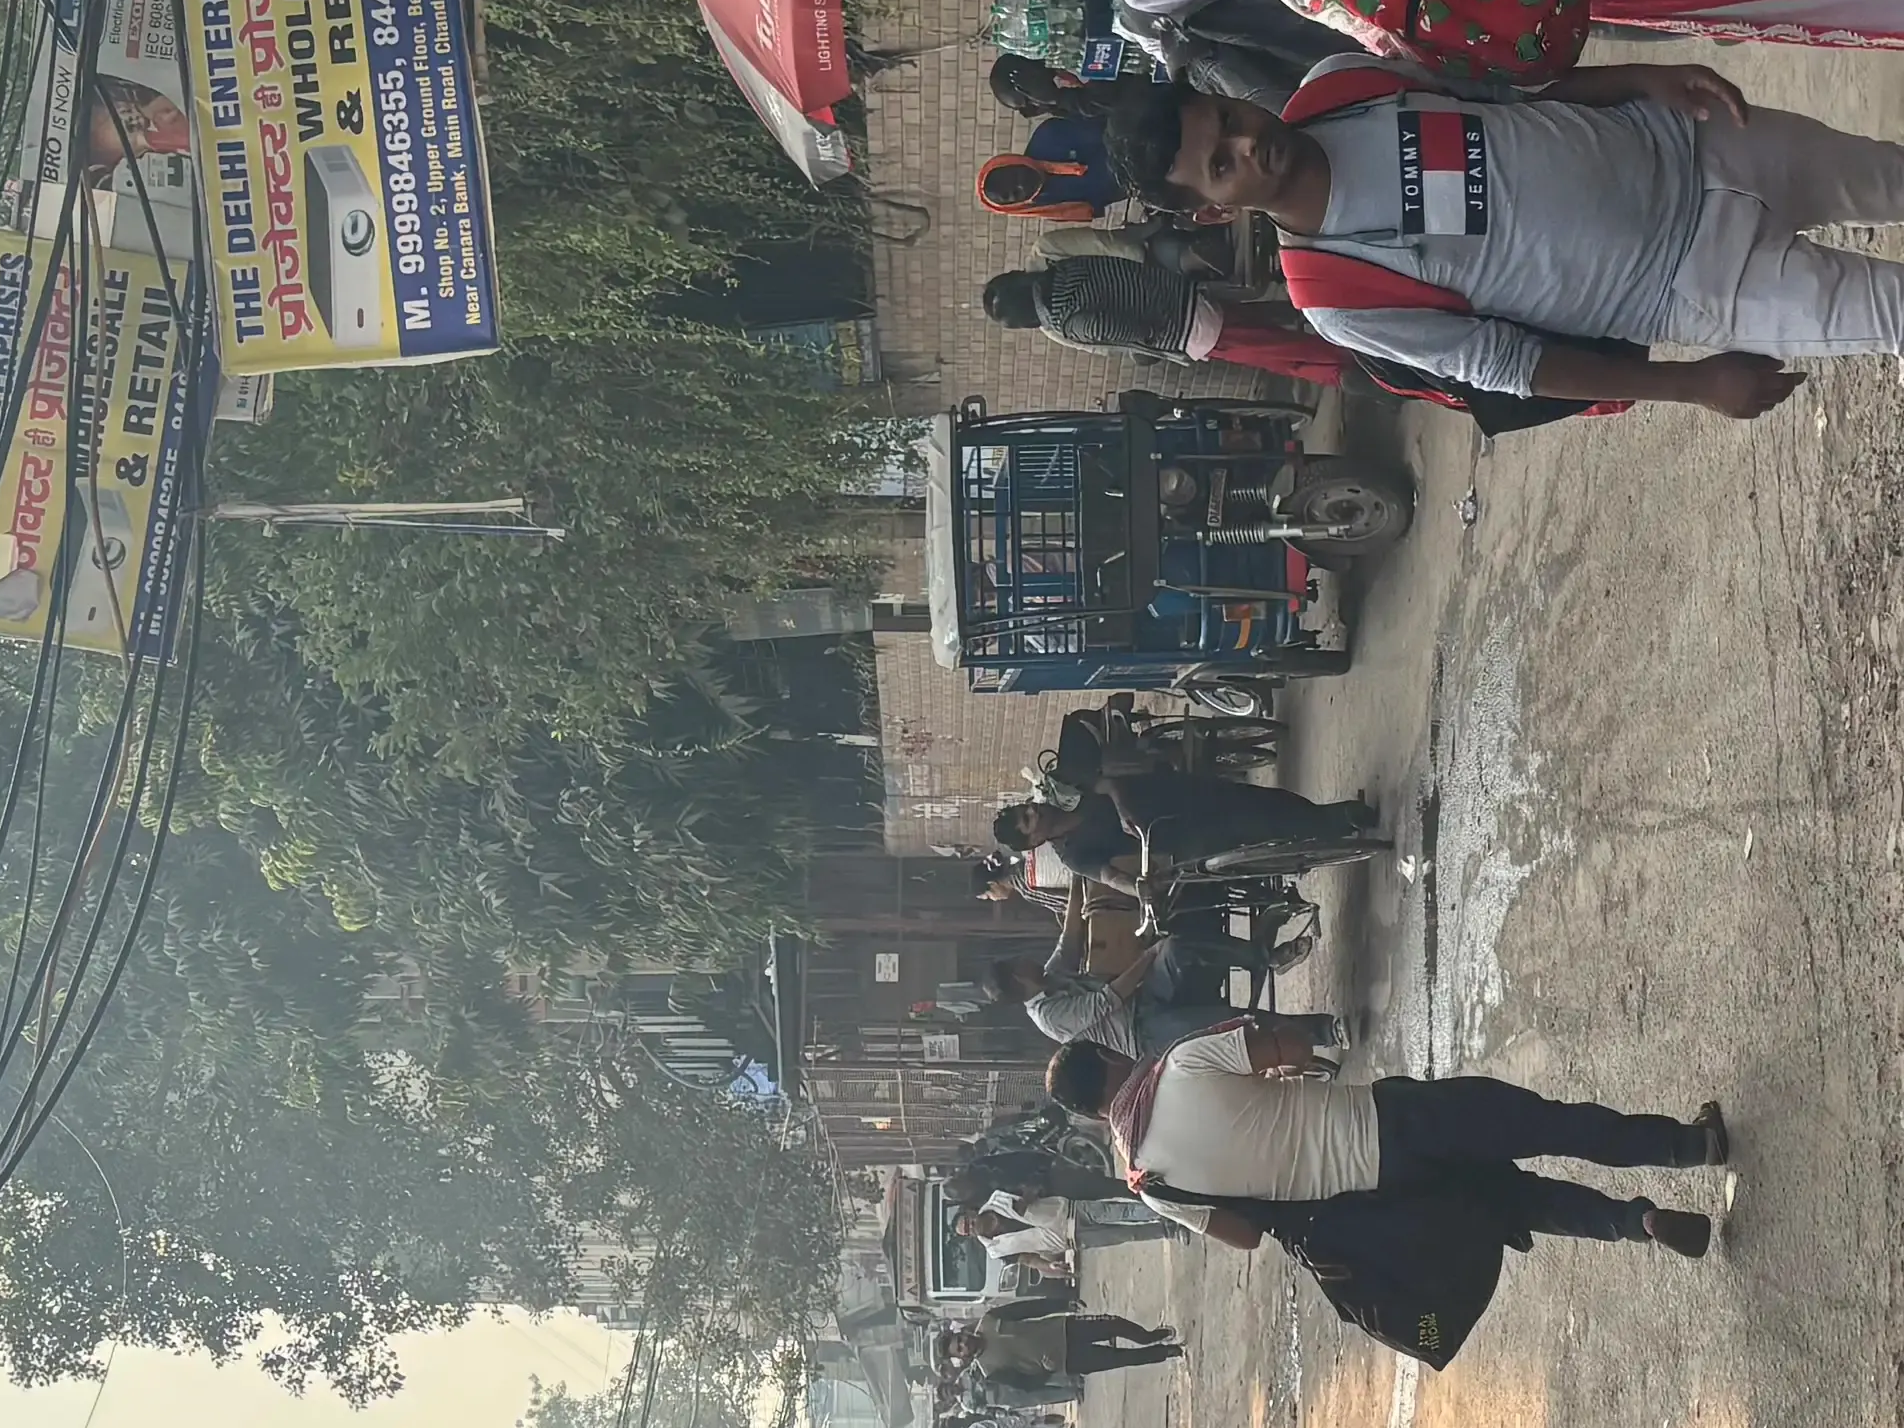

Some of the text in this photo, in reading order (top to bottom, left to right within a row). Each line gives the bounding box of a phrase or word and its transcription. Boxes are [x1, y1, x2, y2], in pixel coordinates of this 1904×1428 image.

[146, 33, 160, 58] IEC
[411, 22, 429, 71] Floor,
[815, 10, 832, 71] LIGHTING
[51, 64, 73, 112] NOW
[253, 85, 282, 109] ही
[414, 76, 437, 138] Ground
[438, 60, 457, 109] Road,
[52, 116, 67, 130] IS
[336, 87, 365, 135] &
[446, 114, 464, 158] Main
[378, 58, 425, 274] 9999846355,
[425, 144, 446, 193] Upper
[452, 163, 470, 214] Bank,
[1403, 131, 1420, 211] TOMMY
[1466, 132, 1483, 210] JEANS
[216, 141, 256, 253] DELHI
[430, 198, 448, 215] 2,
[258, 119, 314, 340] प्रोजेक्टर
[433, 221, 450, 249] No.
[457, 218, 477, 280] Canara
[437, 255, 455, 298] Shop
[231, 267, 265, 343] THE
[403, 286, 432, 330] M.
[463, 285, 481, 325] Near
[115, 279, 177, 487] & RETAIL
[24, 428, 56, 446] ही
